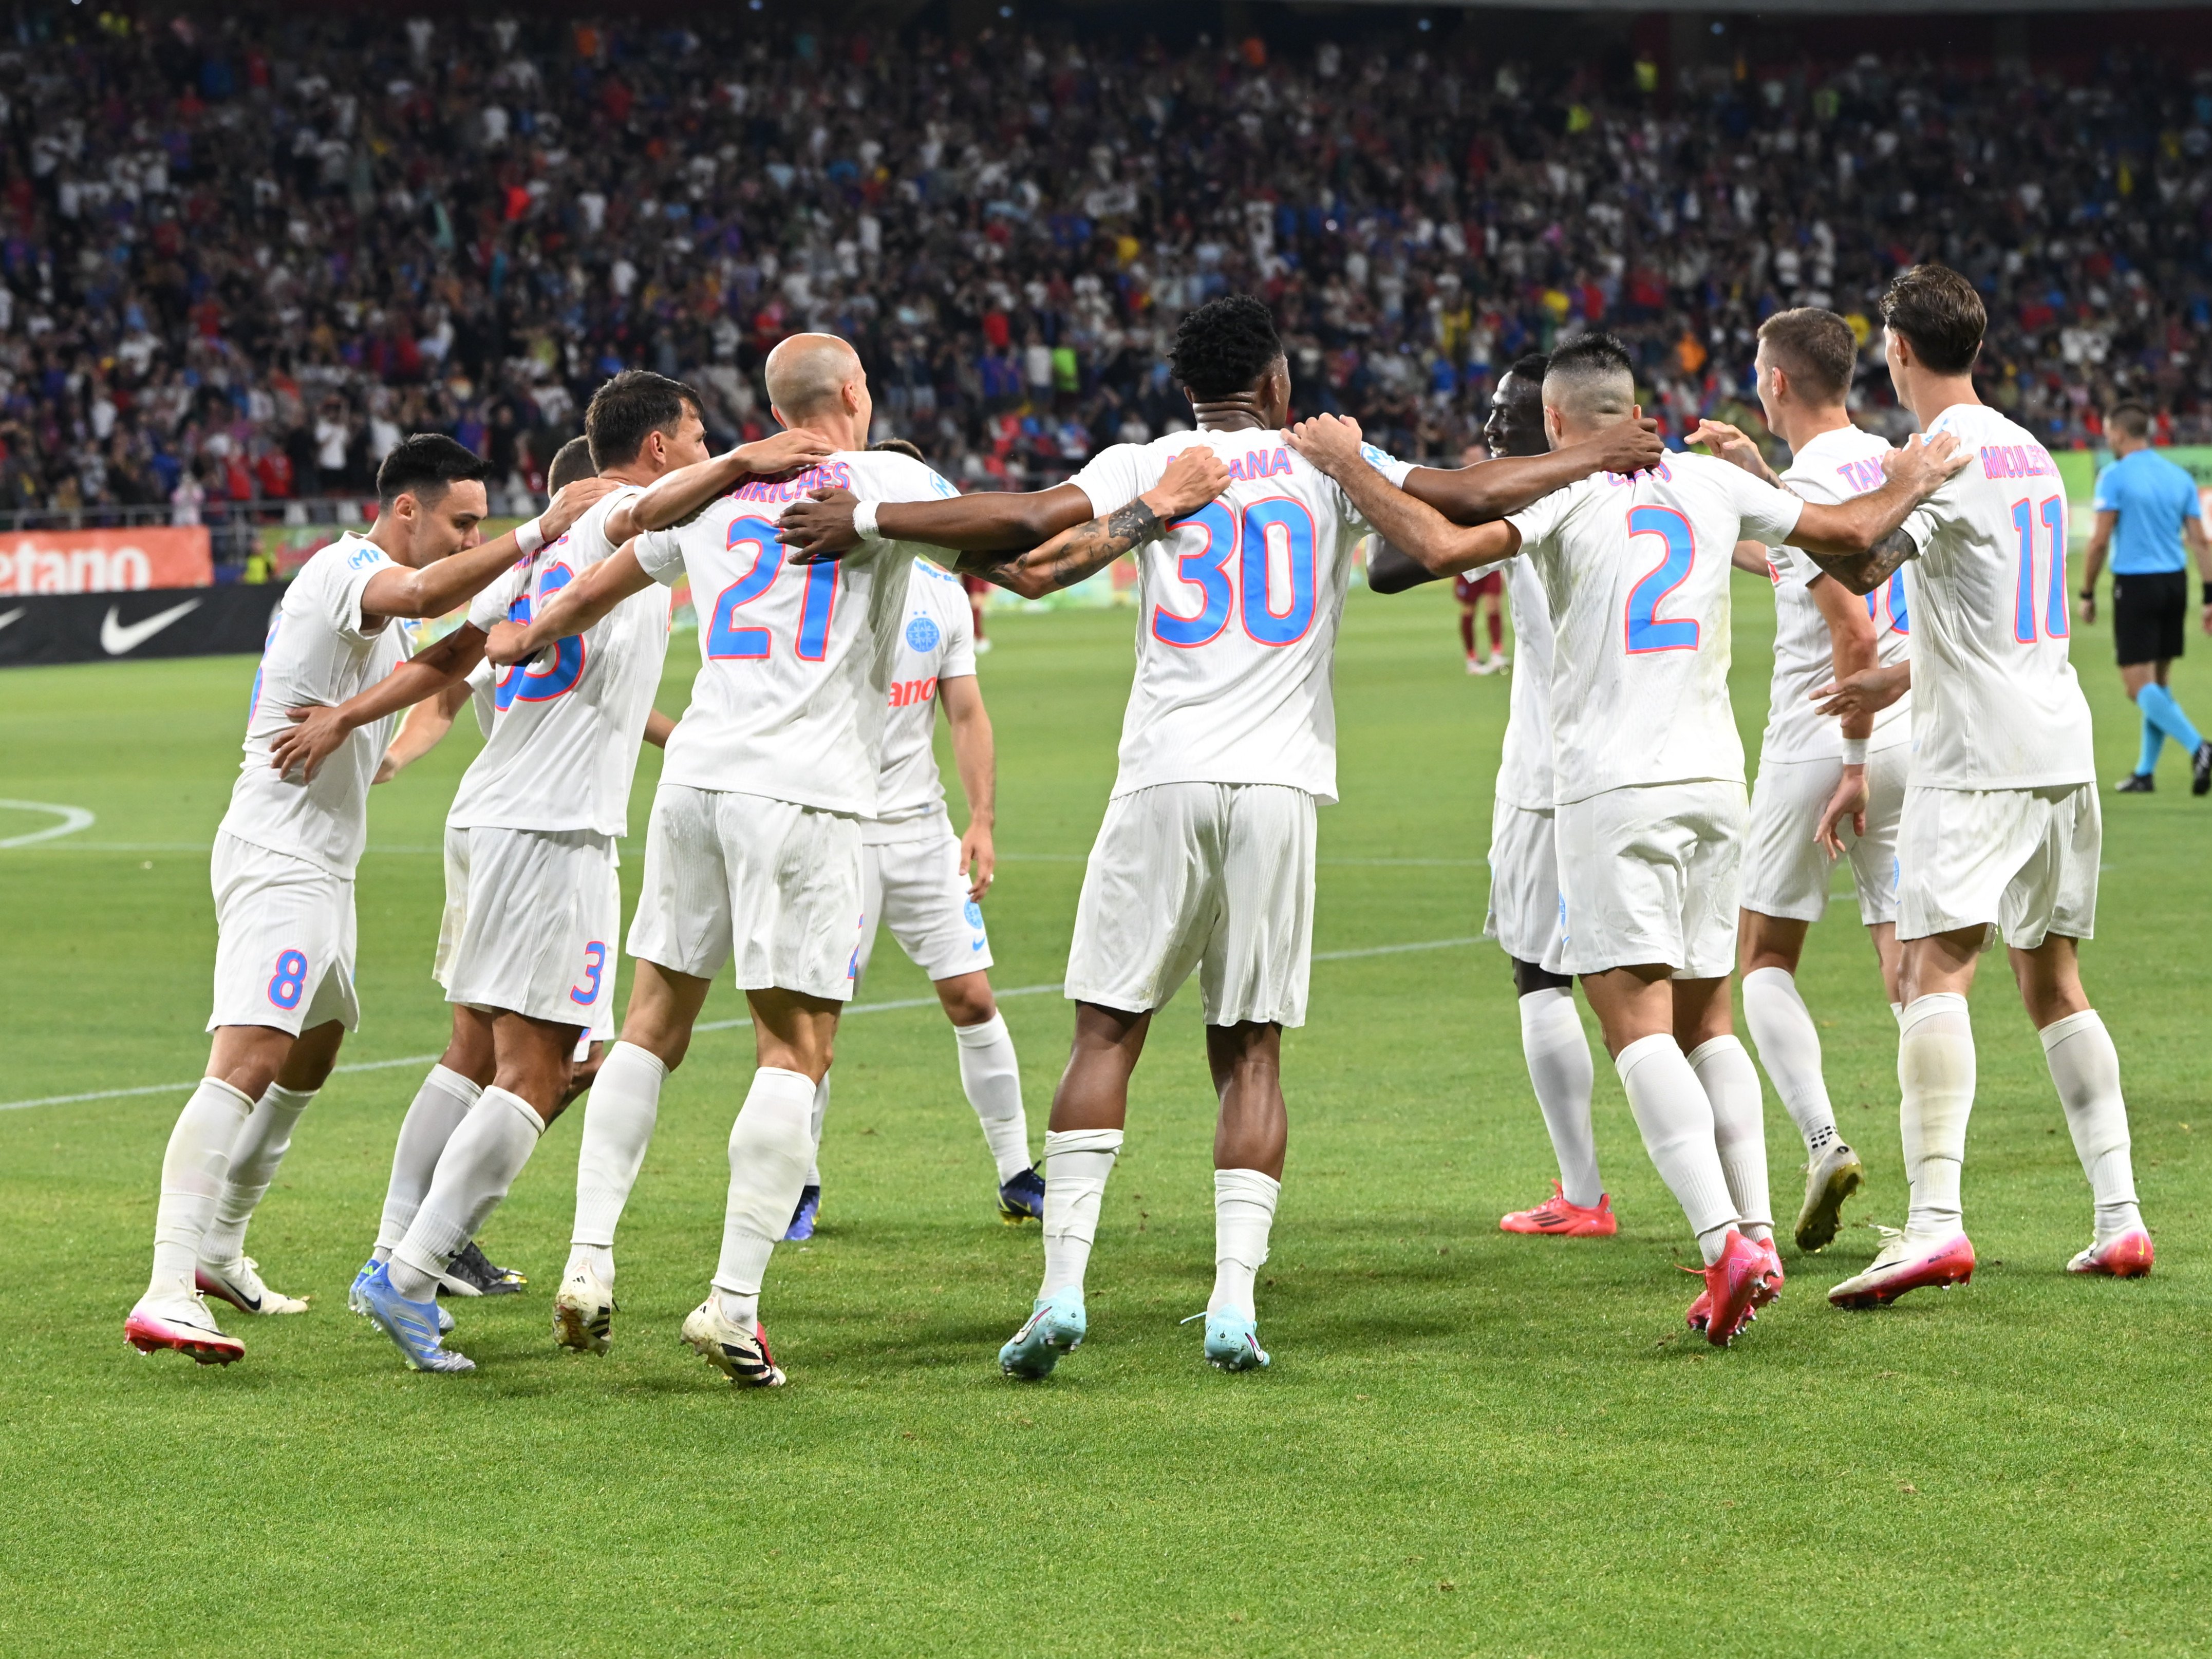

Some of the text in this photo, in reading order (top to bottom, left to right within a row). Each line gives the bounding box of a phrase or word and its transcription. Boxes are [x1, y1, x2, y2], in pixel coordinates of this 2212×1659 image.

[1152, 496, 1316, 649] 30
[1625, 504, 1700, 655] 2
[2011, 494, 2069, 644] 11
[267, 949, 308, 1011] 8
[570, 940, 606, 1006] 3
